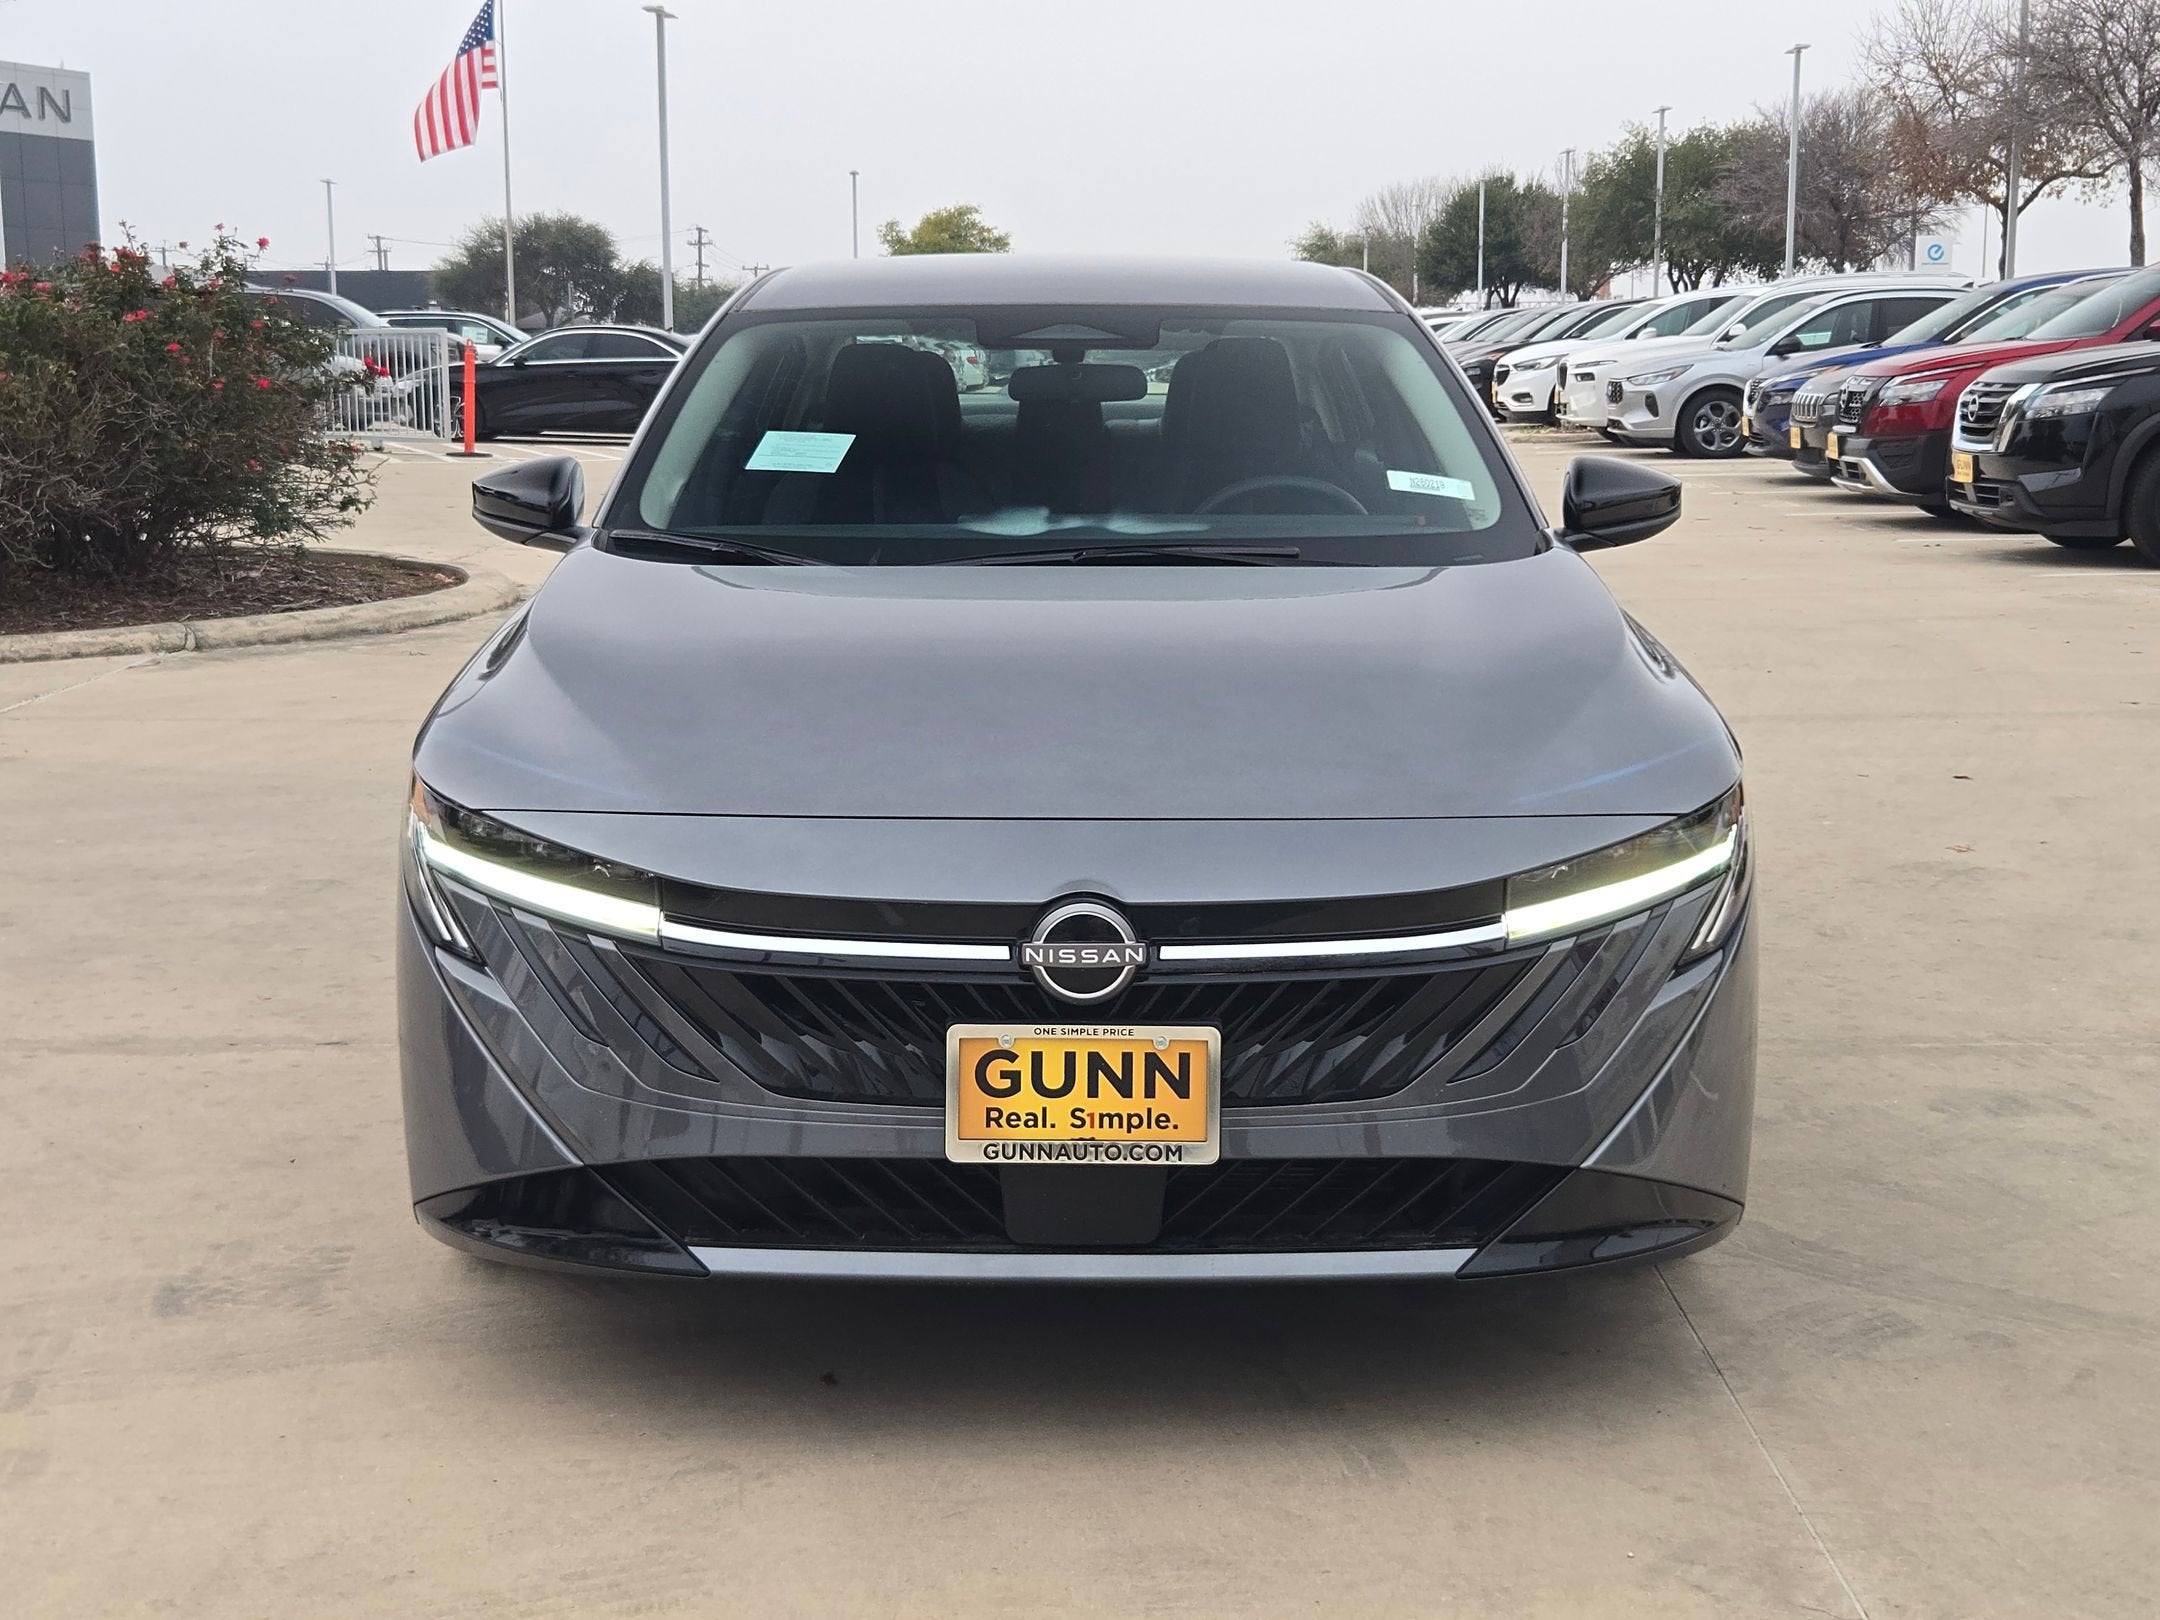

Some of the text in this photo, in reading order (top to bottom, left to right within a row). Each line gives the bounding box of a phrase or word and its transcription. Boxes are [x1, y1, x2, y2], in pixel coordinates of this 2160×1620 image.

[1025, 947, 1144, 964] NISSAN
[1033, 1027, 1135, 1037] ONE SIMPLE PRICE
[974, 1048, 1191, 1100] GUNN
[985, 1106, 1056, 1130] Real.
[983, 1142, 1183, 1162] GUNNAUTO.COM
